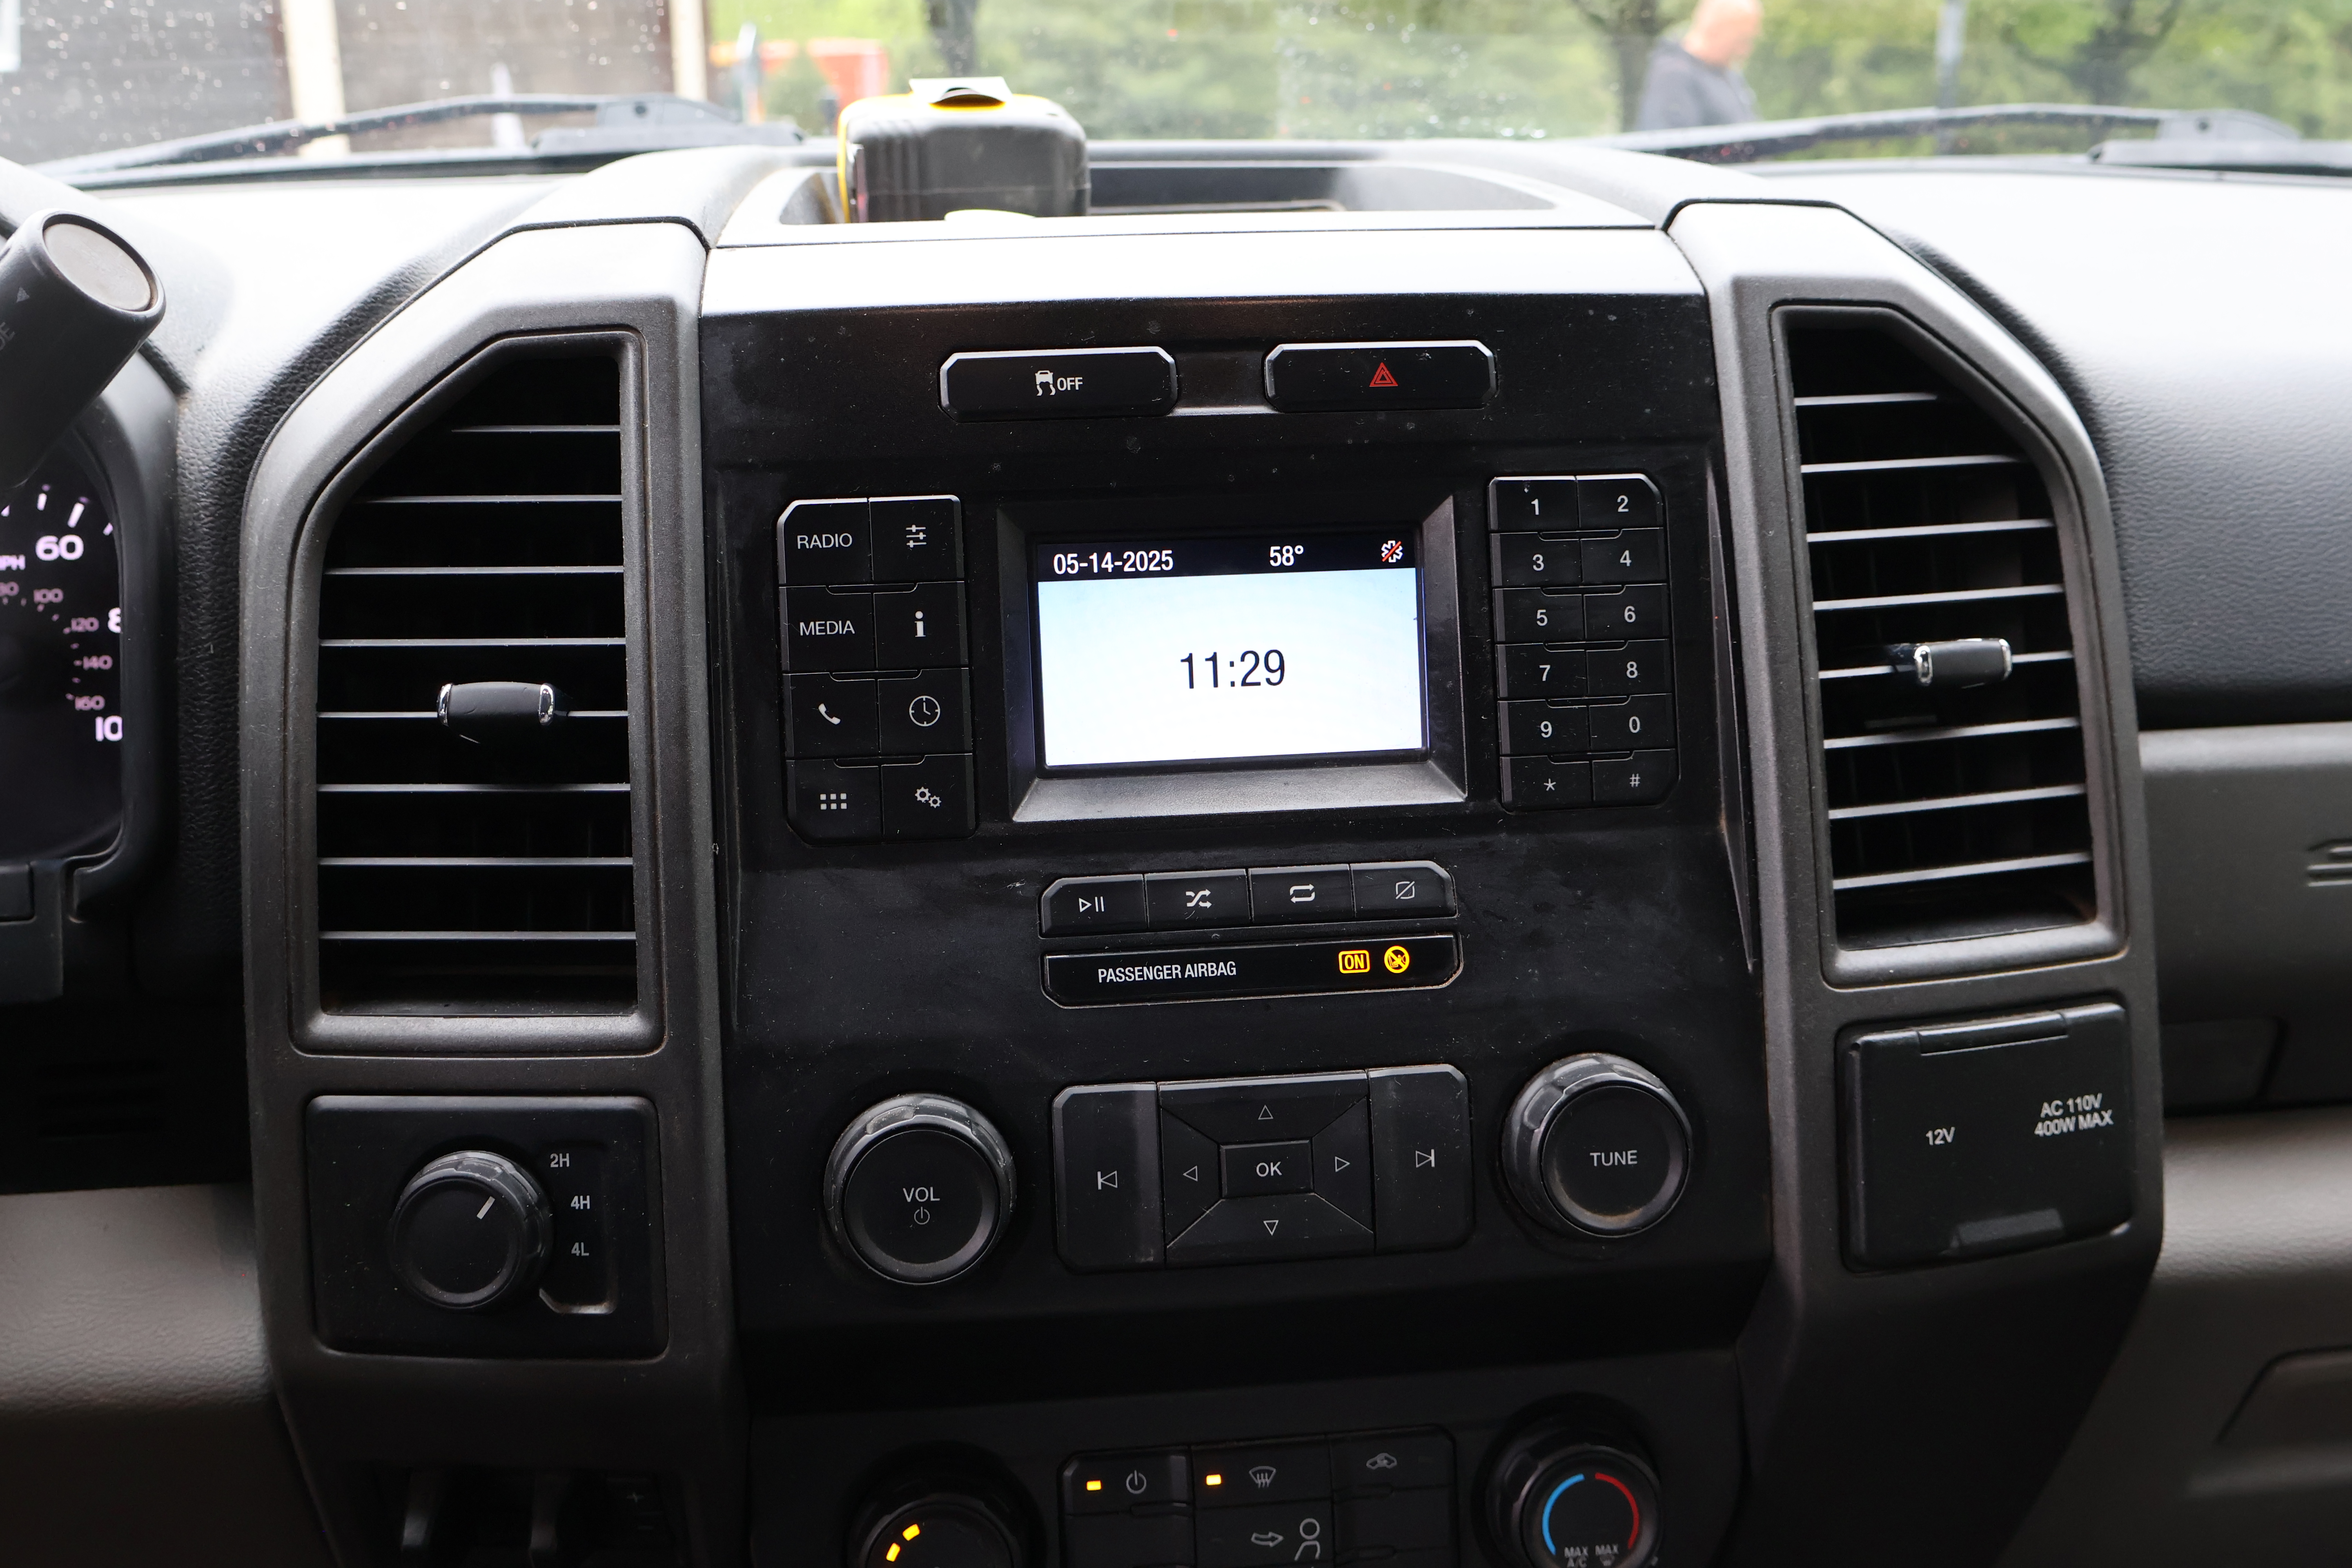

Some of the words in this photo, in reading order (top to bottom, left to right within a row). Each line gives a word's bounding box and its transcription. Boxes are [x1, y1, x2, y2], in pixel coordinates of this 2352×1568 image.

[1057, 377, 1083, 391] OFF
[1531, 499, 1539, 515] 1
[1617, 495, 1629, 512] 2
[35, 534, 84, 561] 60
[797, 533, 853, 549] RADIO
[1053, 550, 1174, 575] 05-14-2025
[1269, 545, 1304, 567] 58°
[1532, 554, 1544, 571] 3
[1620, 550, 1632, 566] 4
[33, 588, 64, 603] 100
[1537, 609, 1548, 626] 5
[1624, 606, 1636, 622] 6
[71, 617, 99, 632] 120
[800, 620, 855, 636] MEDIA
[83, 655, 113, 670] 140
[1181, 650, 1285, 688] 11:29
[1626, 661, 1638, 678] 8
[1539, 664, 1550, 681] 7
[1541, 721, 1552, 738] 9
[1629, 716, 1641, 733] 0
[1630, 773, 1641, 788] #
[1345, 954, 1364, 969] ON
[1098, 965, 1181, 983] PASSENGER
[1184, 961, 1236, 978] AIRBAG
[2040, 1100, 2064, 1118] AC
[2067, 1093, 2102, 1113] 110V
[2034, 1116, 2076, 1137] 400W
[2078, 1109, 2114, 1131] MAX
[1926, 1127, 1955, 1145] 12V
[550, 1153, 570, 1168] 2H
[1590, 1150, 1638, 1167] TUNE
[1256, 1161, 1282, 1177] OK
[571, 1195, 590, 1210] 4H
[903, 1187, 940, 1202] VOL
[571, 1241, 590, 1256] 4L
[1564, 1546, 1588, 1559] MAX
[1595, 1544, 1619, 1556] MAX
